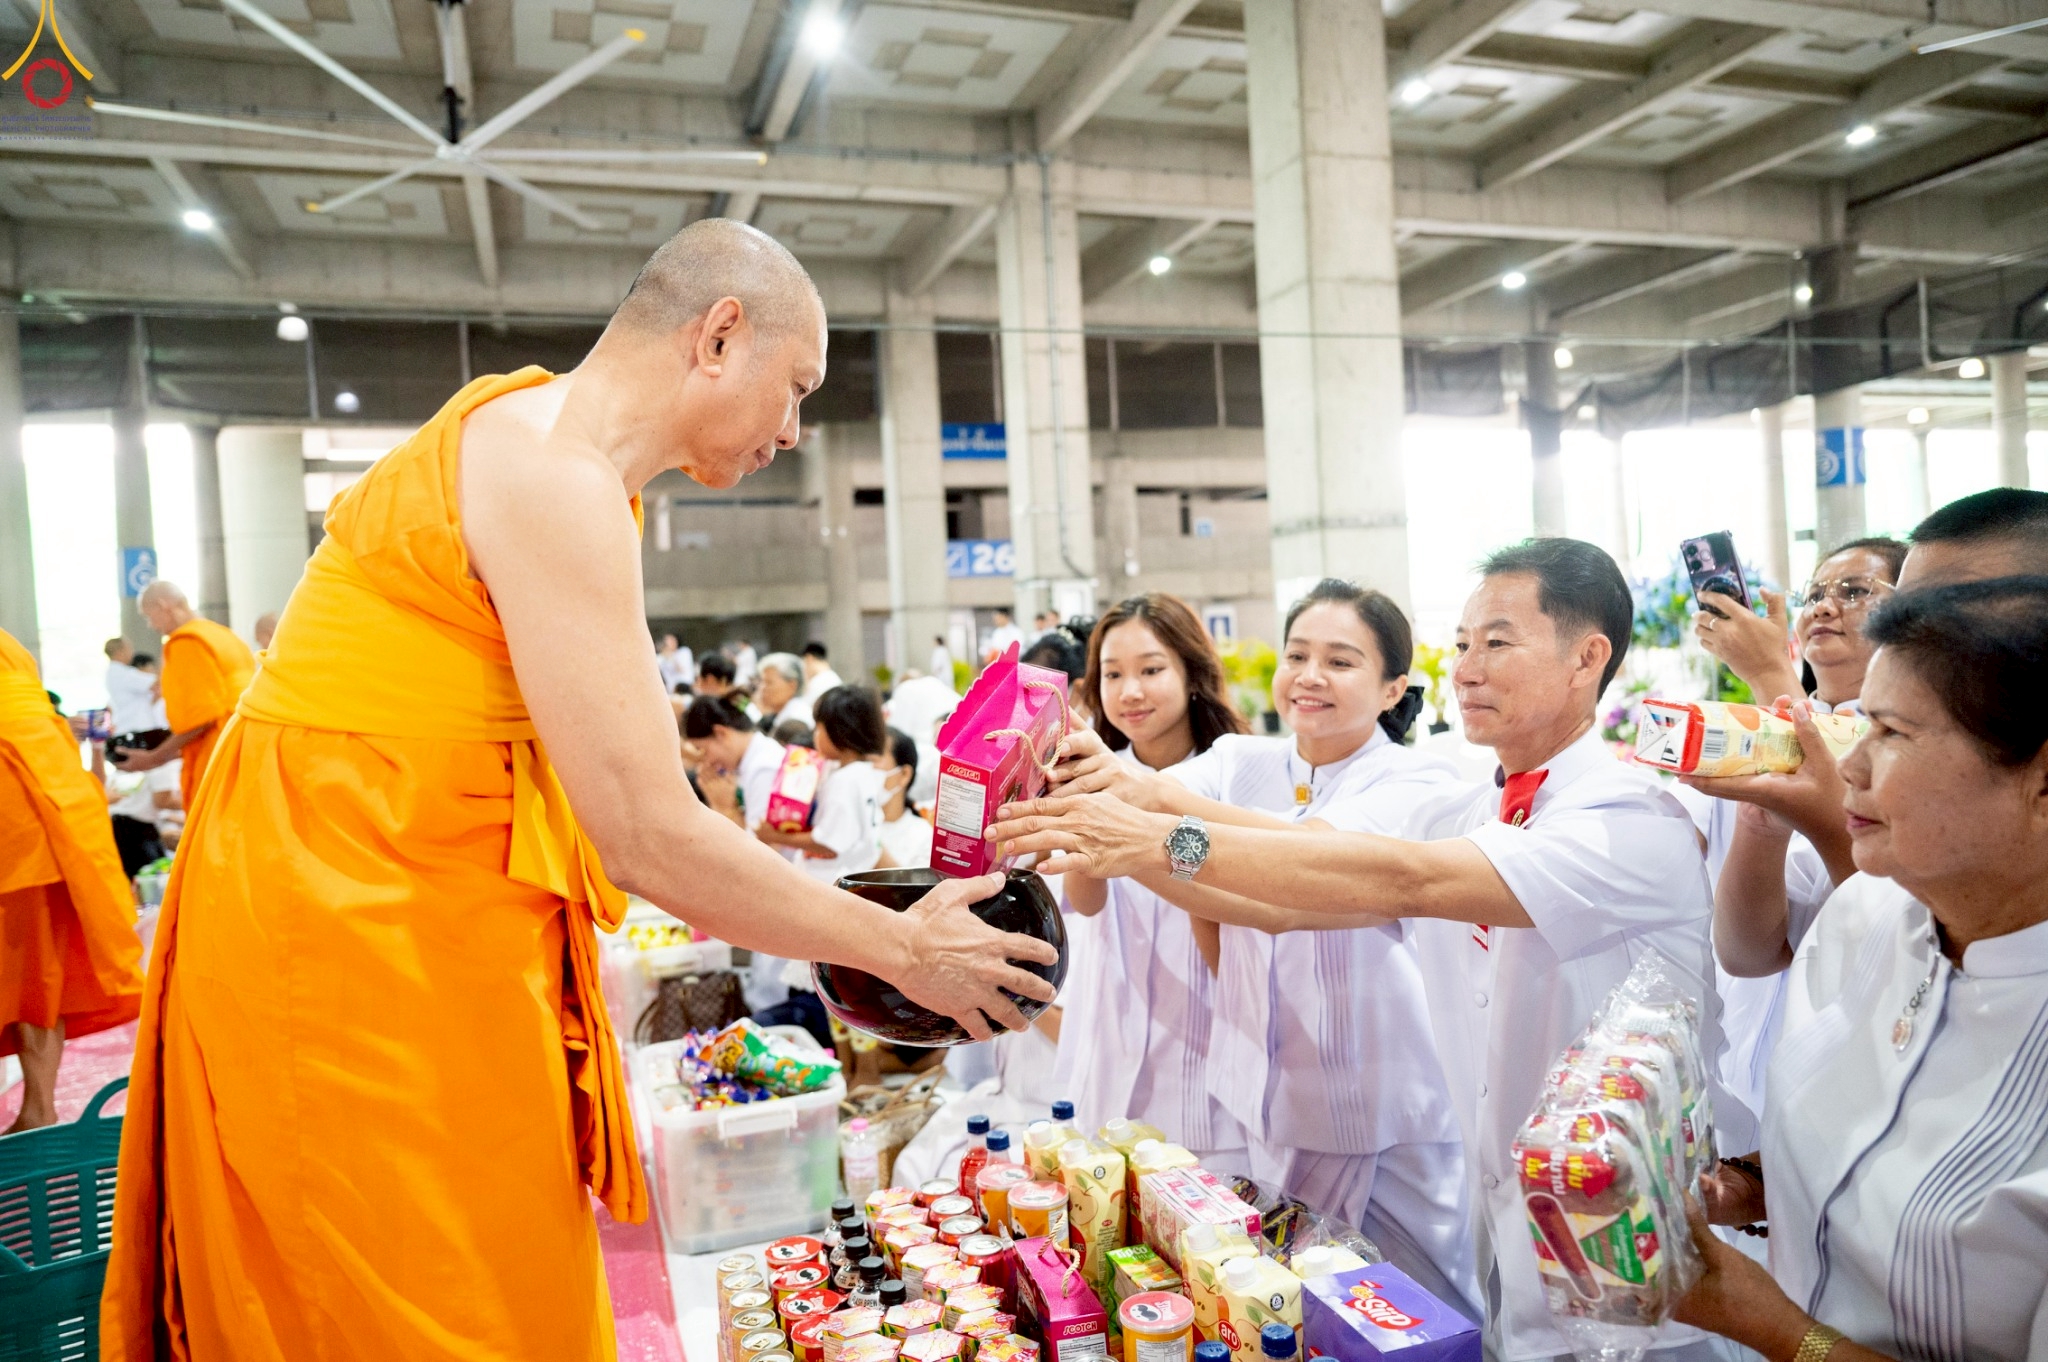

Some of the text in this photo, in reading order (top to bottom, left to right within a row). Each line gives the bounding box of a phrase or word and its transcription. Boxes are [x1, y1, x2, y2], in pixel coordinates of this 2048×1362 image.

[972, 543, 1016, 573] 26
[947, 764, 981, 781] SCOTCH
[1354, 1298, 1412, 1326] Siip
[1063, 1321, 1098, 1336] SCOTCH
[1221, 1323, 1238, 1346] aro
